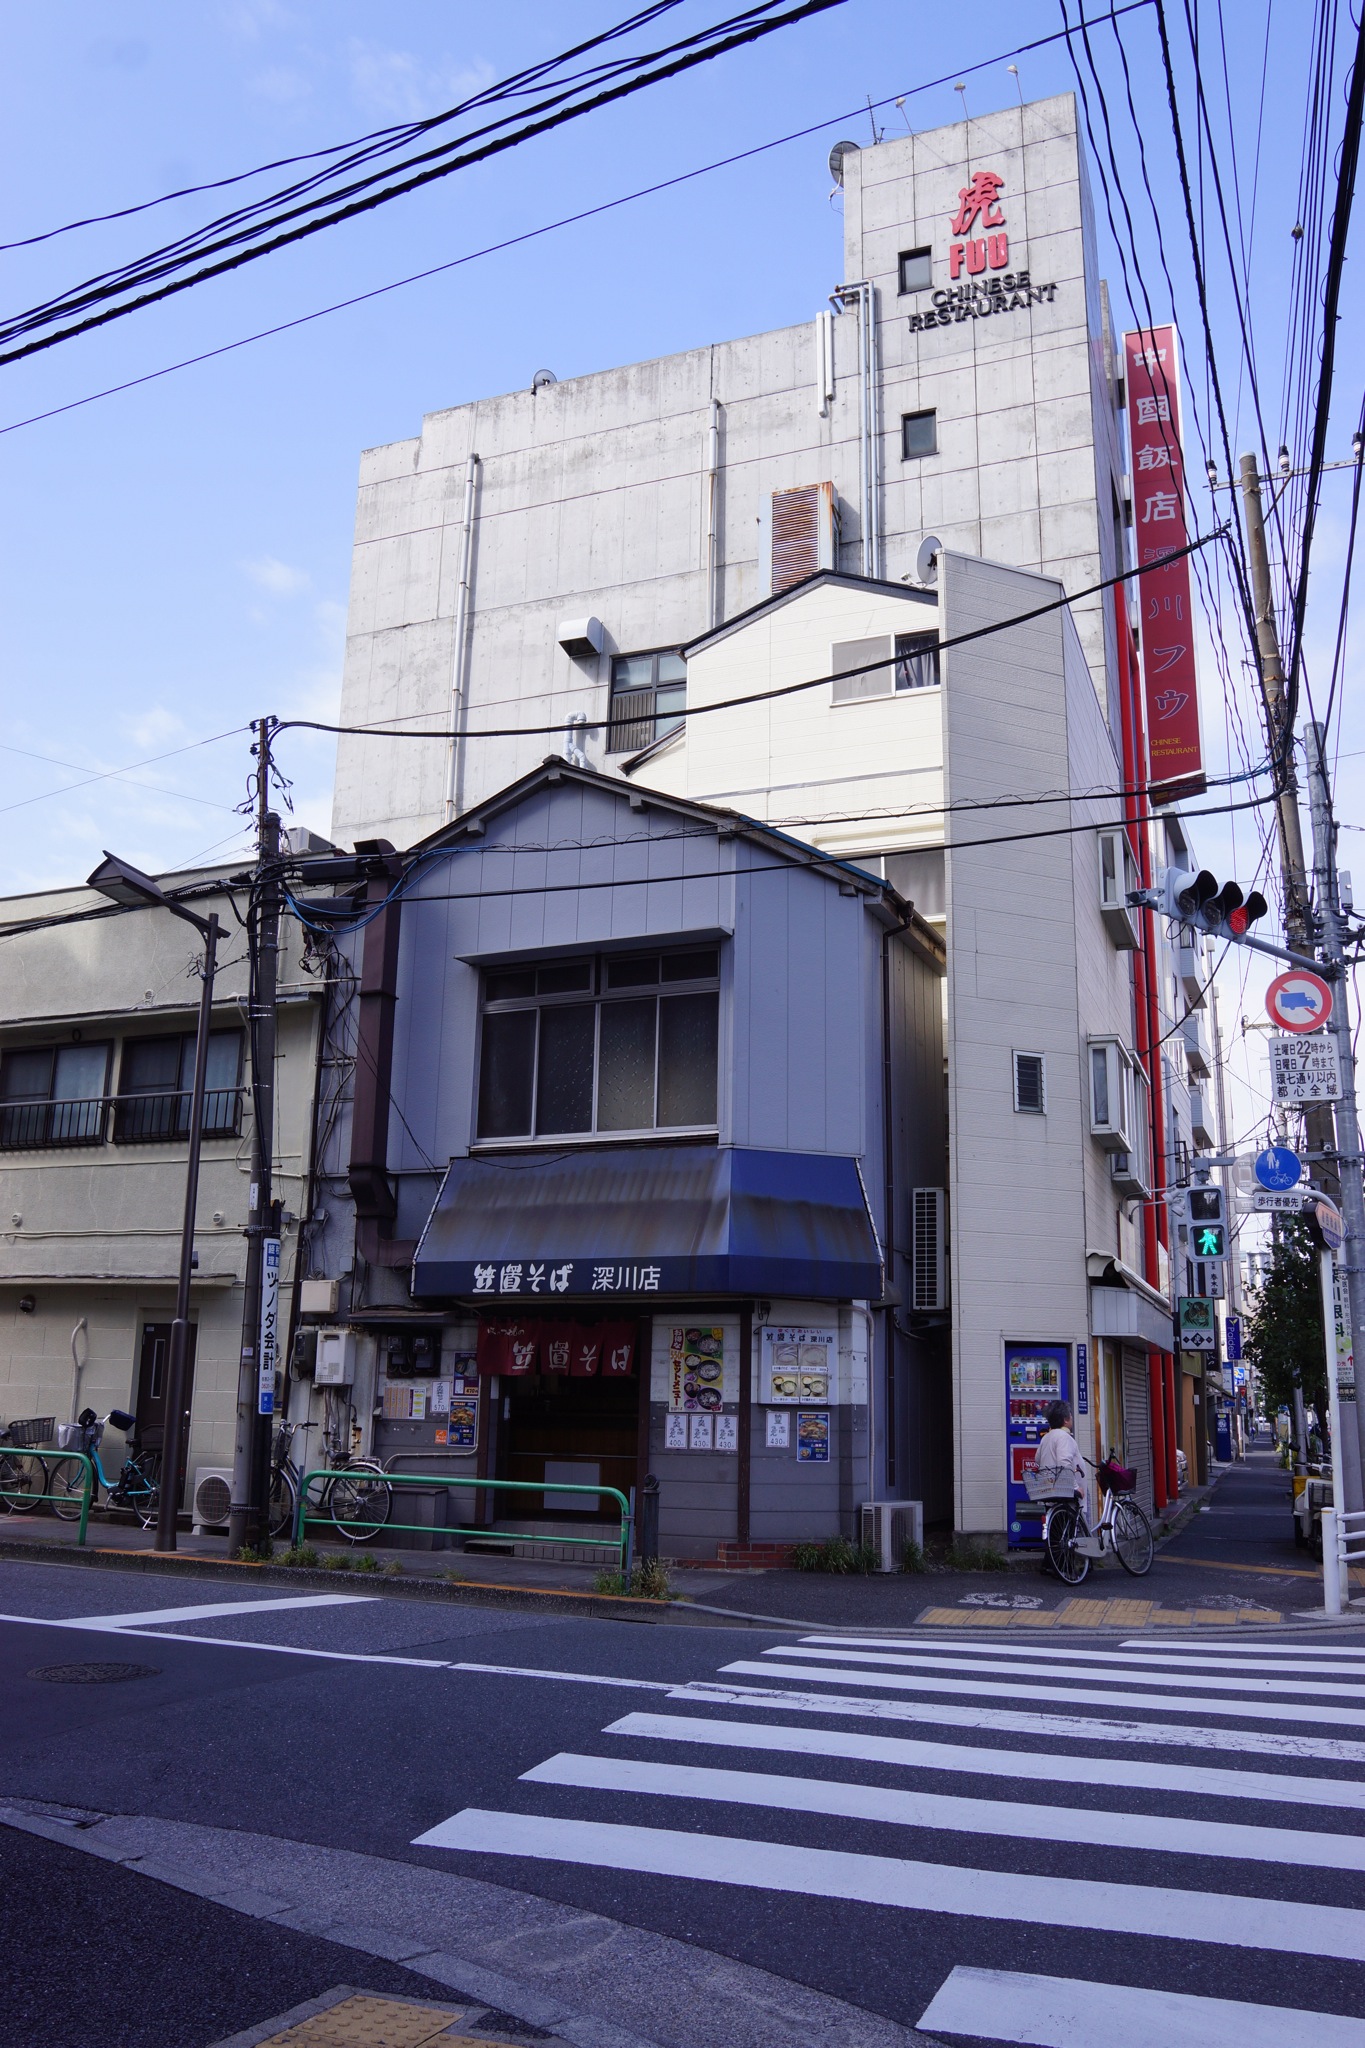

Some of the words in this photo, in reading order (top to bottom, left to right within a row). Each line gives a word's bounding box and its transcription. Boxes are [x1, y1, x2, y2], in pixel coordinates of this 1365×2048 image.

[949, 172, 1005, 236] 虎
[949, 233, 1009, 281] FUU
[931, 271, 1031, 308] CHINESE
[908, 284, 1058, 334] RESTAURANT
[1150, 737, 1182, 748] CHINESE
[1151, 746, 1199, 759] RESTAURANT
[1274, 1040, 1334, 1057] 土曜日22時から
[1275, 1055, 1336, 1071] 日曜日7時まで
[1276, 1071, 1338, 1086] 環七通り以内
[1277, 1084, 1338, 1098] 都心全域
[1257, 1196, 1299, 1209] 歩行者優先
[472, 1262, 574, 1294] 笠置そば
[592, 1266, 662, 1292] 深川店
[511, 1340, 632, 1372] 笠置そば
